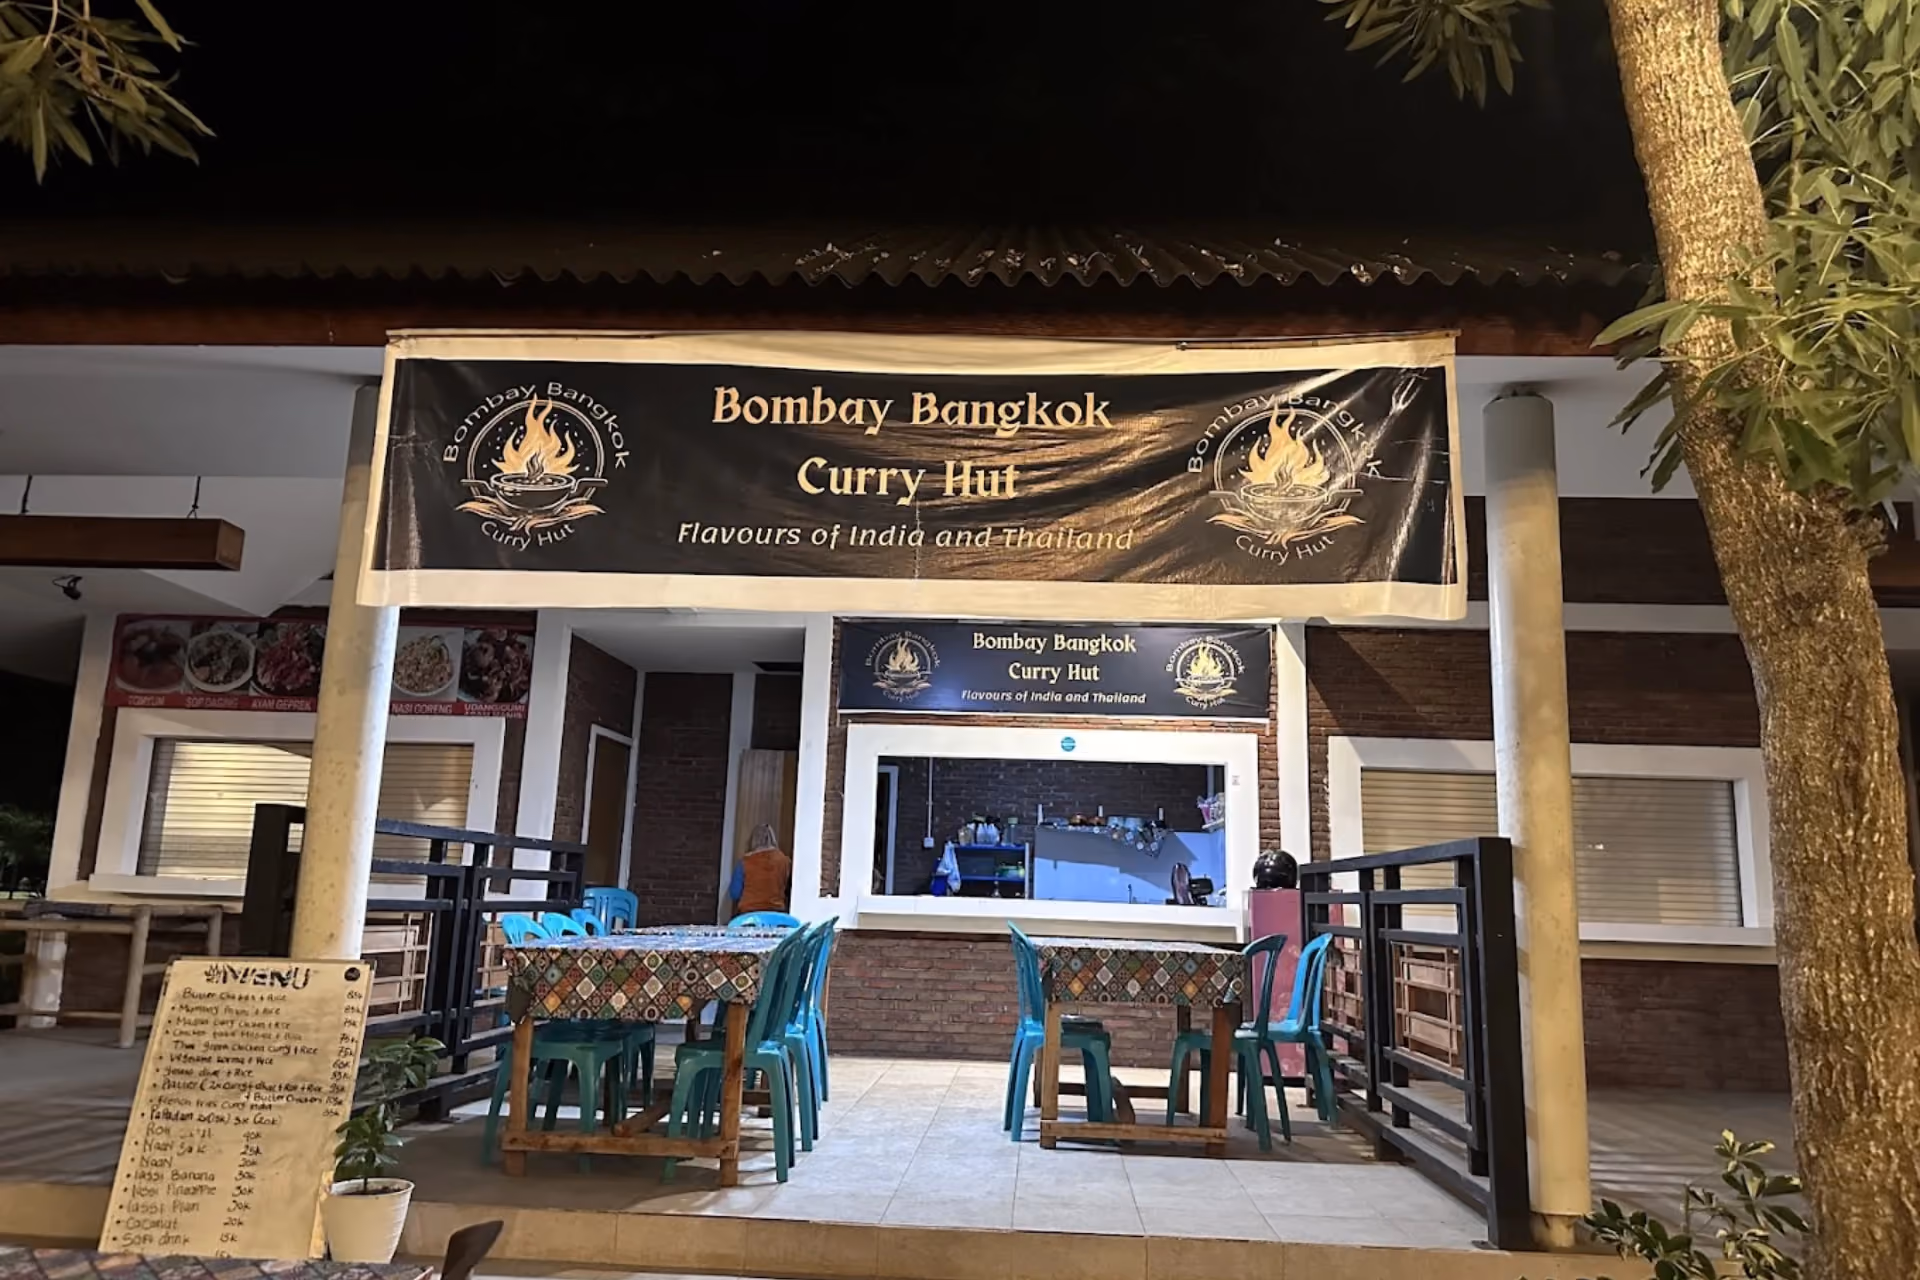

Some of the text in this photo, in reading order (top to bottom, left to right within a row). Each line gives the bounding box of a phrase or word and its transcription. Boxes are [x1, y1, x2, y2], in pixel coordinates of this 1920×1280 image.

[443, 381, 630, 469] Bombay Bangkok
[712, 386, 1113, 437] Bombay Bangkok
[1188, 392, 1383, 478] Bombay Bangkok
[797, 457, 1020, 506] Curry Hut
[481, 520, 575, 551] Curry Hut
[678, 522, 1134, 550] Flavours of India and Thailand
[1236, 535, 1335, 566] Curry Hut
[973, 632, 1138, 656] Bombay Bangkok
[1008, 661, 1101, 684] Curry Hut
[391, 703, 453, 714] NASI GORENG
[961, 689, 1147, 704] Flavours of India and Thailand
